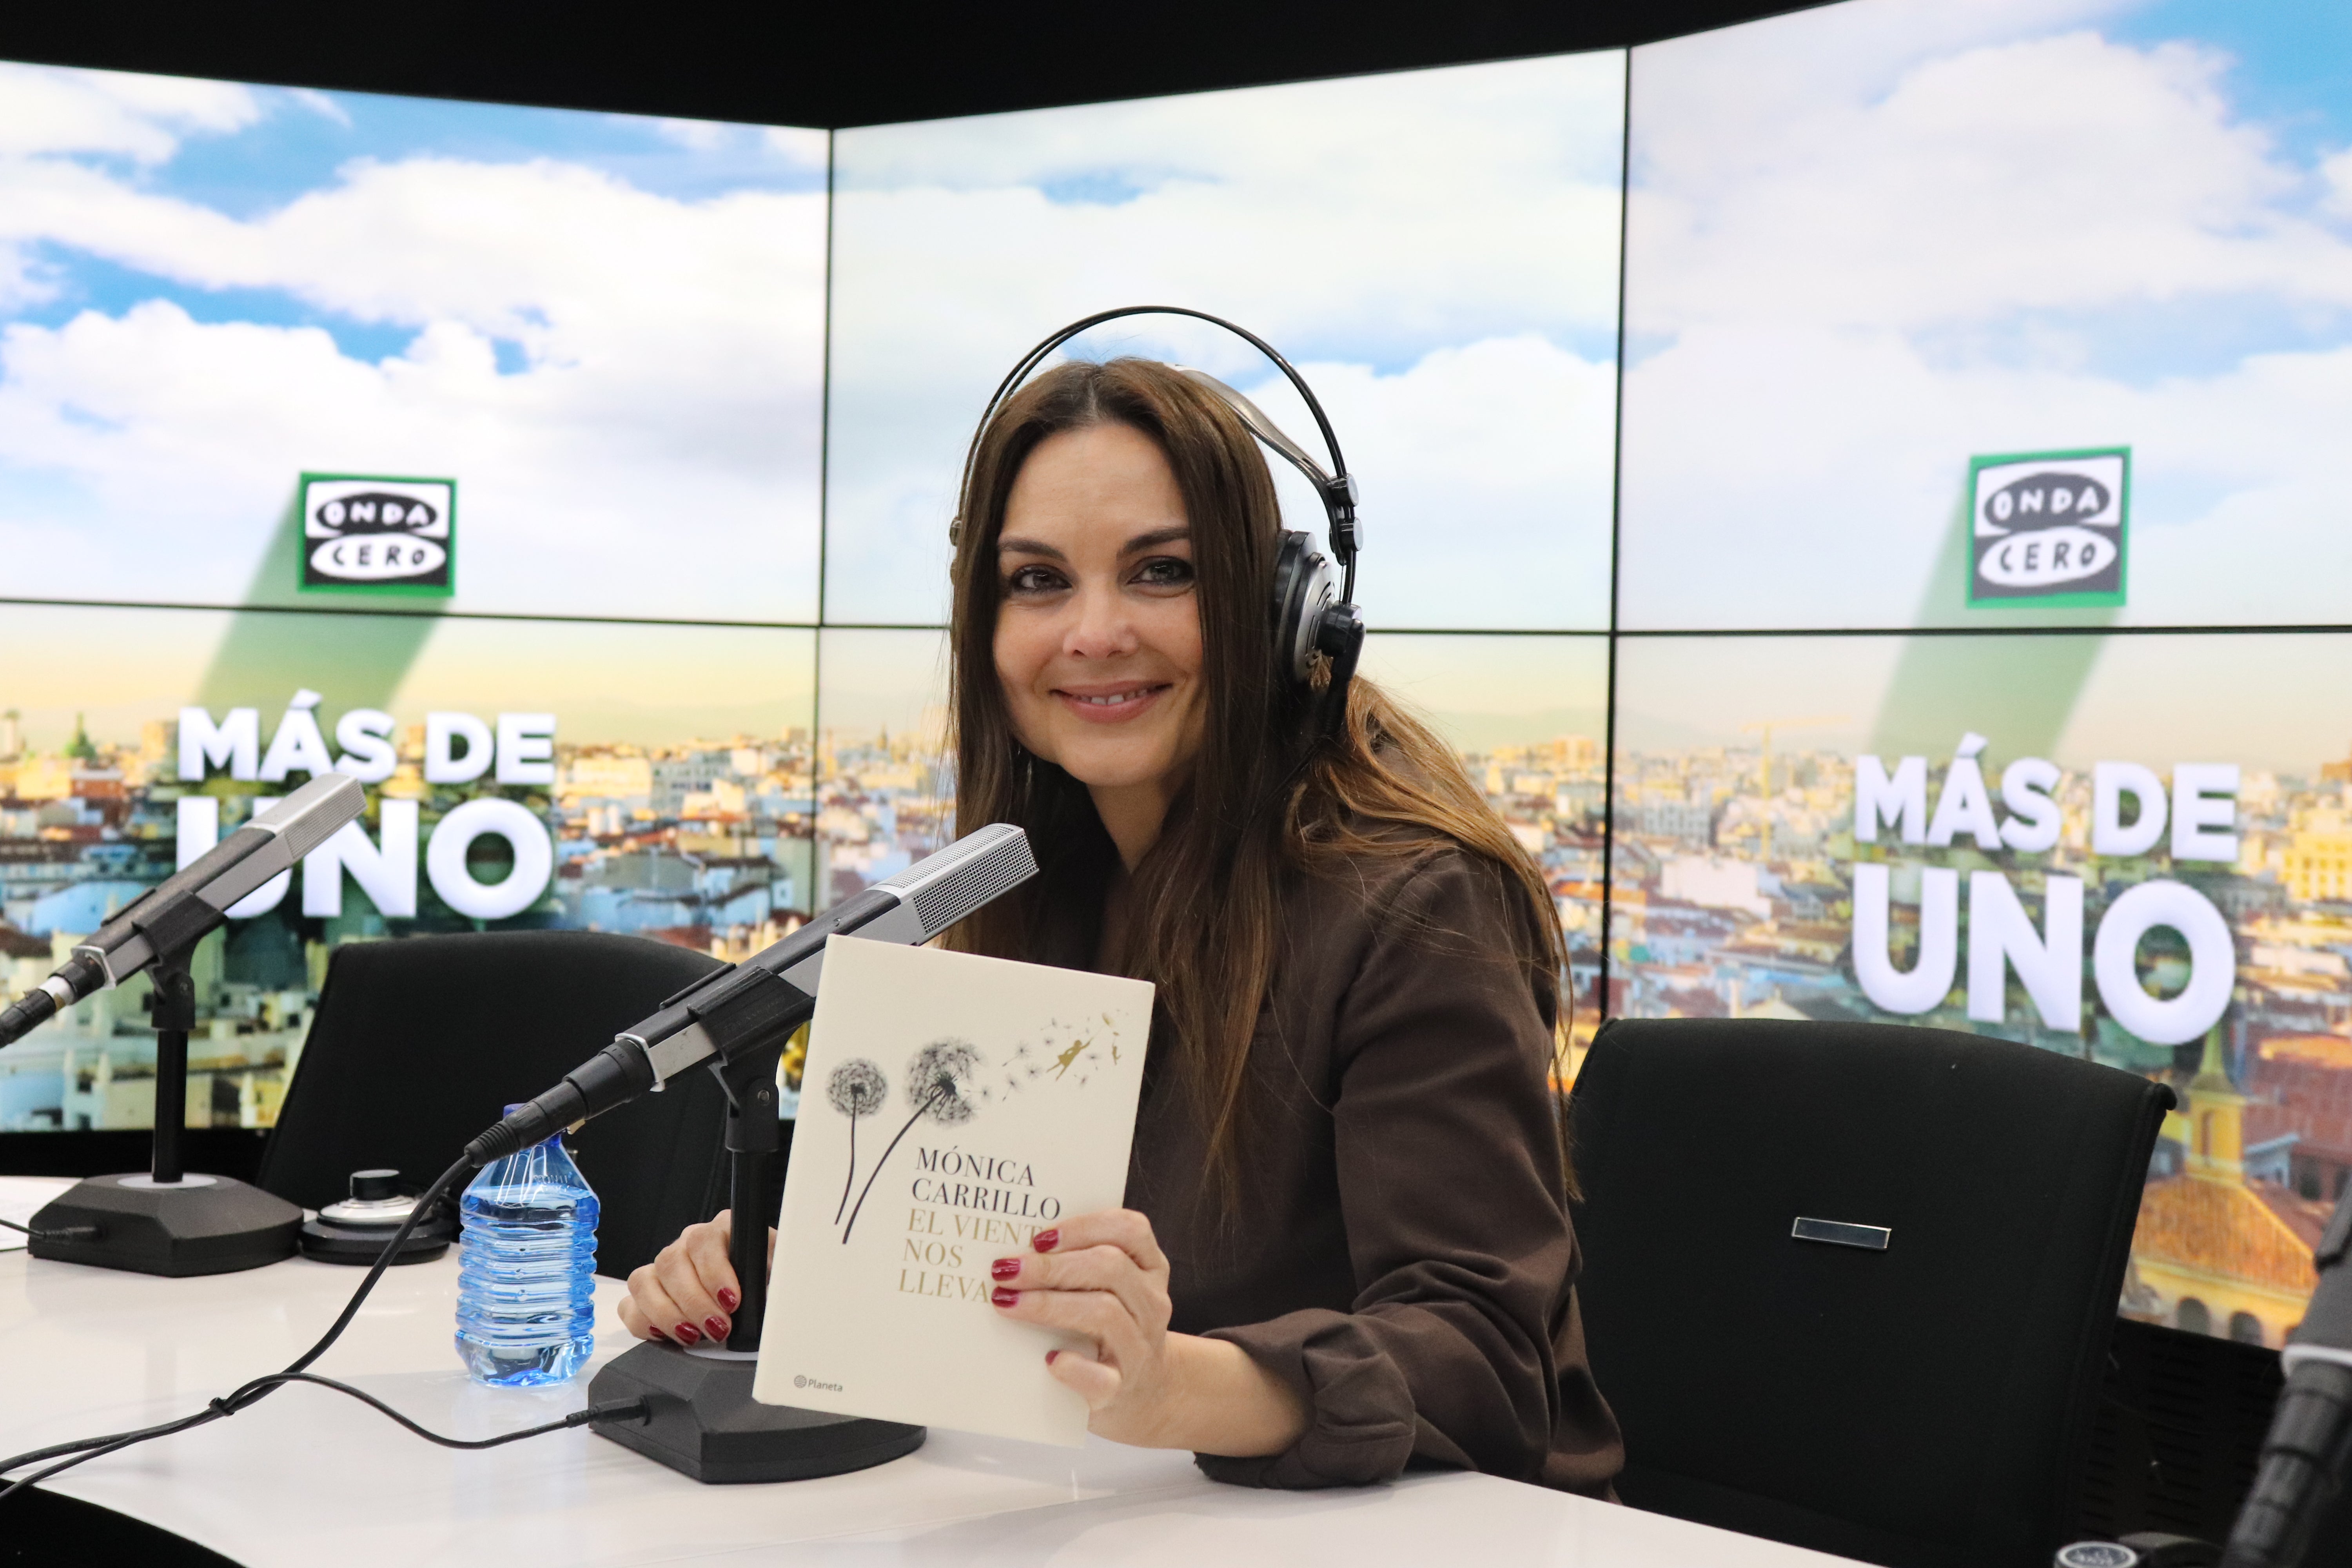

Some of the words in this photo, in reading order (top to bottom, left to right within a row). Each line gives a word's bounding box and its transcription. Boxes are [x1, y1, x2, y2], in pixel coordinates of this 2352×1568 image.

[324, 501, 430, 528] ONDA
[1993, 486, 2100, 521] ONDA
[333, 544, 425, 566] CERO
[1999, 541, 2097, 573] CERO
[178, 688, 397, 785] MÁS
[425, 711, 556, 784] DE
[1855, 731, 2063, 852] MÁS
[2092, 761, 2241, 862] DE
[1853, 863, 2236, 1045] UNO
[915, 1145, 1035, 1187] MÓNICA
[912, 1178, 1061, 1220] CARRILLO
[907, 1208, 943, 1235] EL
[953, 1214, 1043, 1248] VIENT
[902, 1238, 963, 1269] NOS
[808, 1379, 843, 1392] Planeta
